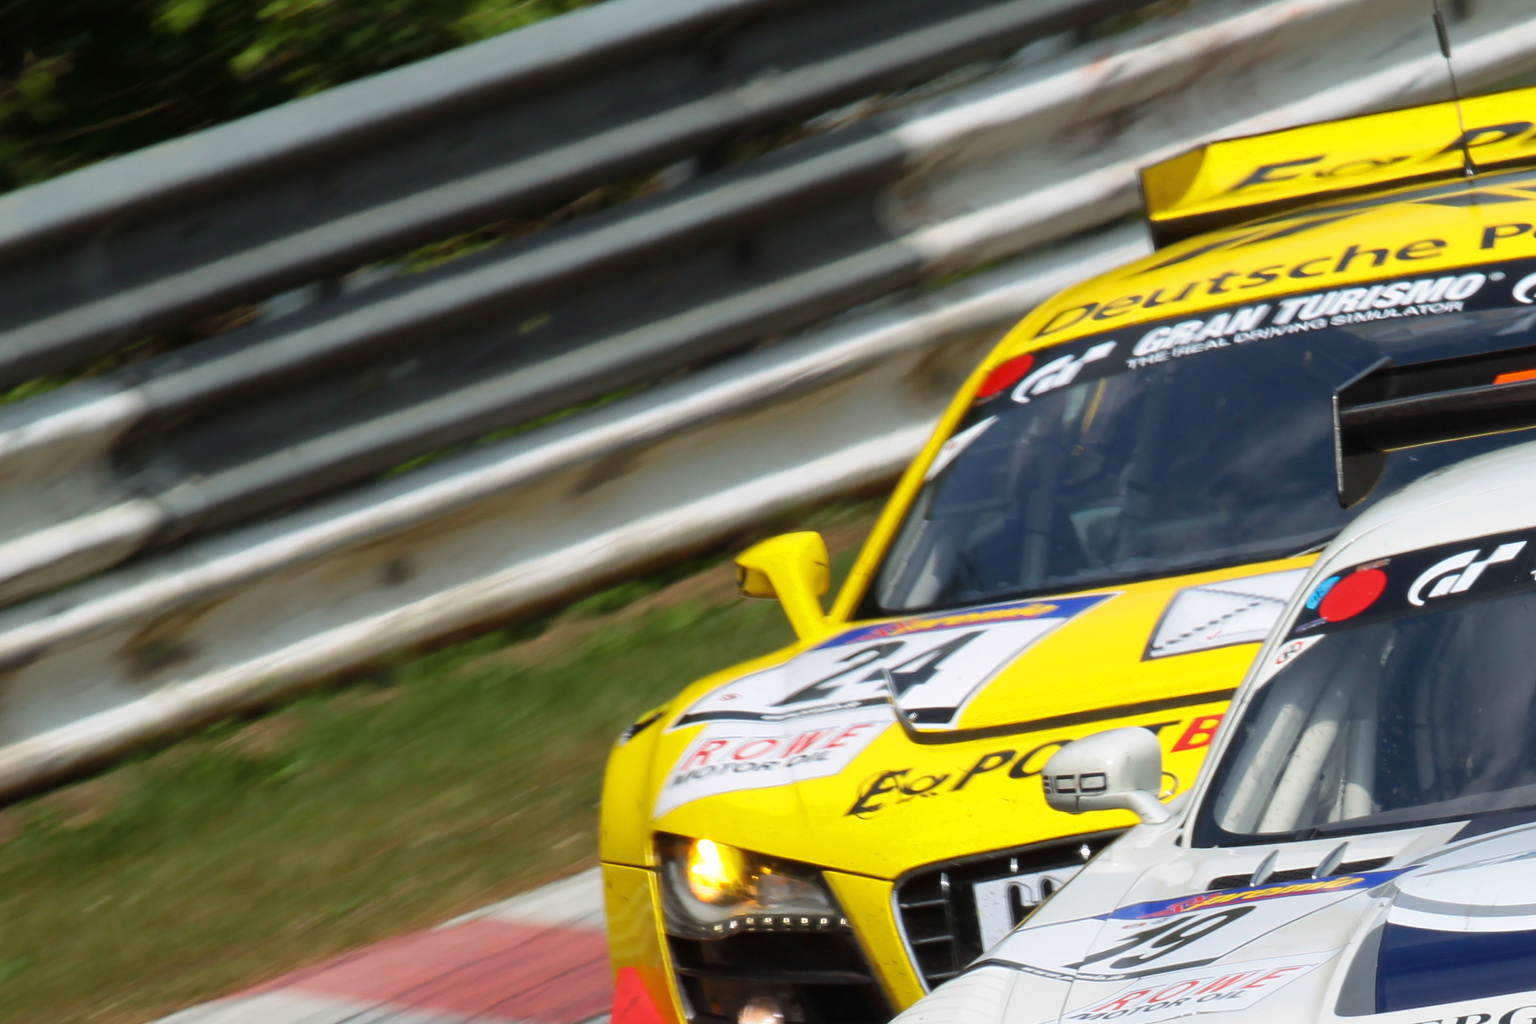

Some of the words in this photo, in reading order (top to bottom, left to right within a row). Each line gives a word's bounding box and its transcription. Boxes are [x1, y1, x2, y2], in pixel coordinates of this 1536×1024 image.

[1031, 238, 1448, 341] Deutsche
[1131, 303, 1272, 358] GRAN
[1272, 272, 1487, 326] TURISMO
[1126, 351, 1172, 370] THE
[1172, 337, 1231, 359] REAL
[1233, 318, 1329, 344] DRIVING
[1330, 300, 1464, 328] SIMULATOR
[768, 629, 991, 706] 24
[670, 760, 778, 787] MOTOR
[785, 751, 831, 769] OIL
[680, 723, 877, 772] ROWE
[1061, 904, 1257, 969] 19
[1066, 996, 1194, 1021] MOTOR
[1196, 989, 1246, 1004] OIL
[1093, 964, 1302, 1013] ROWE
